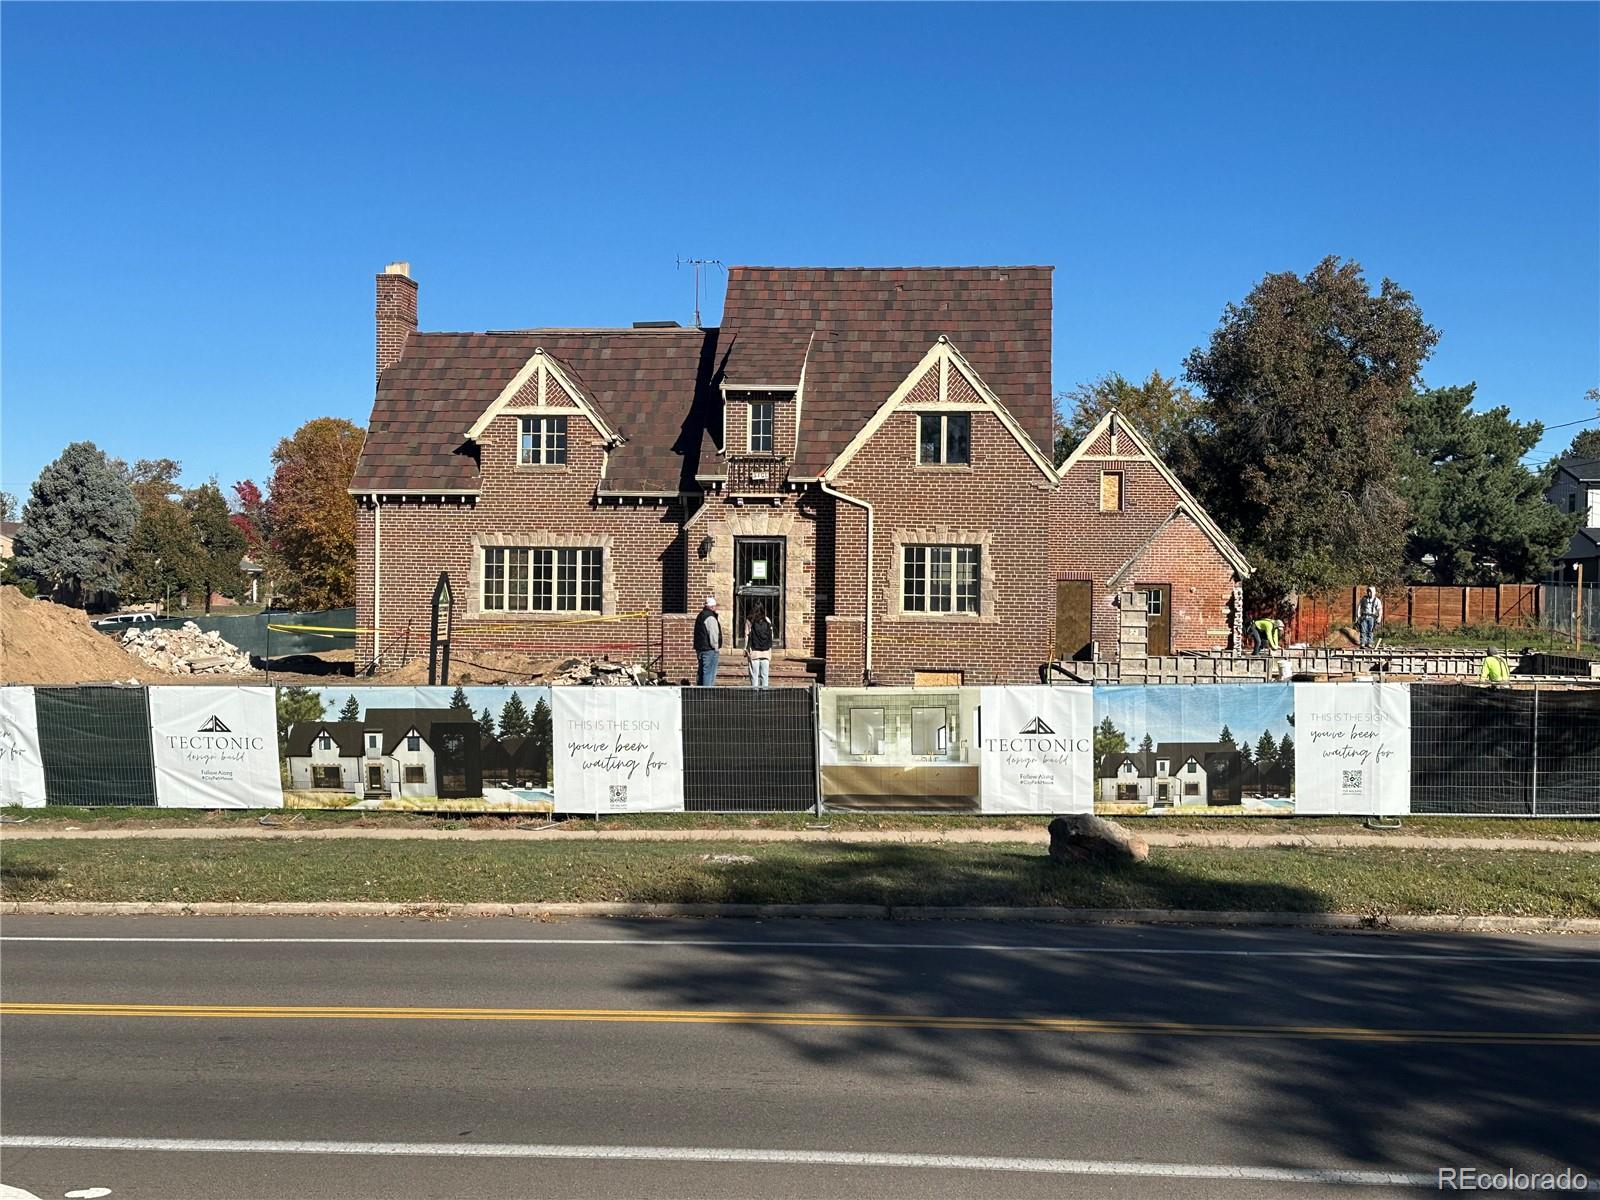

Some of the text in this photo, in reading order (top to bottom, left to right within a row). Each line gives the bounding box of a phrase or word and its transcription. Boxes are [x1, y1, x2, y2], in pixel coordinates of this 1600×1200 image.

[1310, 712, 1389, 721] THIS IS THE SIGN
[567, 719, 660, 731] THIS IS THE SIGN
[1350, 723, 1380, 740] been
[166, 735, 264, 751] TECTONIC
[615, 733, 648, 754] been
[984, 738, 1090, 753] TECTONIC
[186, 751, 246, 765] design build
[1006, 754, 1069, 768] design build
[1322, 743, 1395, 766] waiting for
[582, 751, 668, 780] waiting for
